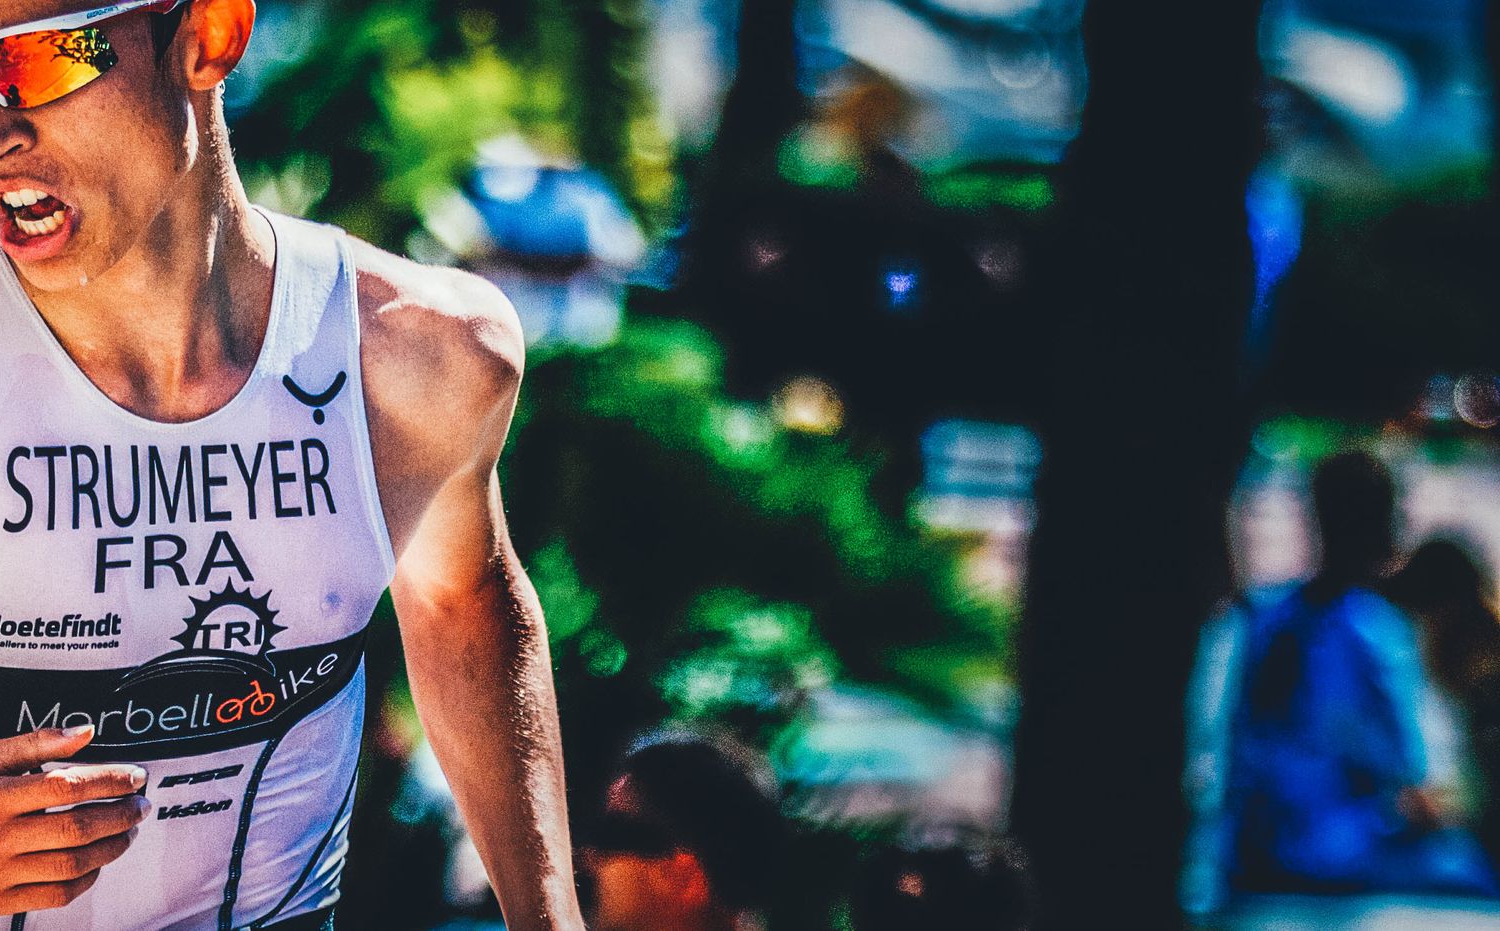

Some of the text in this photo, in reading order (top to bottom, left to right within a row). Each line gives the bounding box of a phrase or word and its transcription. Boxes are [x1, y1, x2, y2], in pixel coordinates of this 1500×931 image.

[2, 438, 337, 533] STRUMEYER
[94, 531, 255, 594] FRA
[40, 642, 65, 650] meet
[67, 642, 89, 652] your
[91, 640, 119, 649] needs
[199, 619, 263, 650] TRI
[157, 799, 233, 820] Vision
